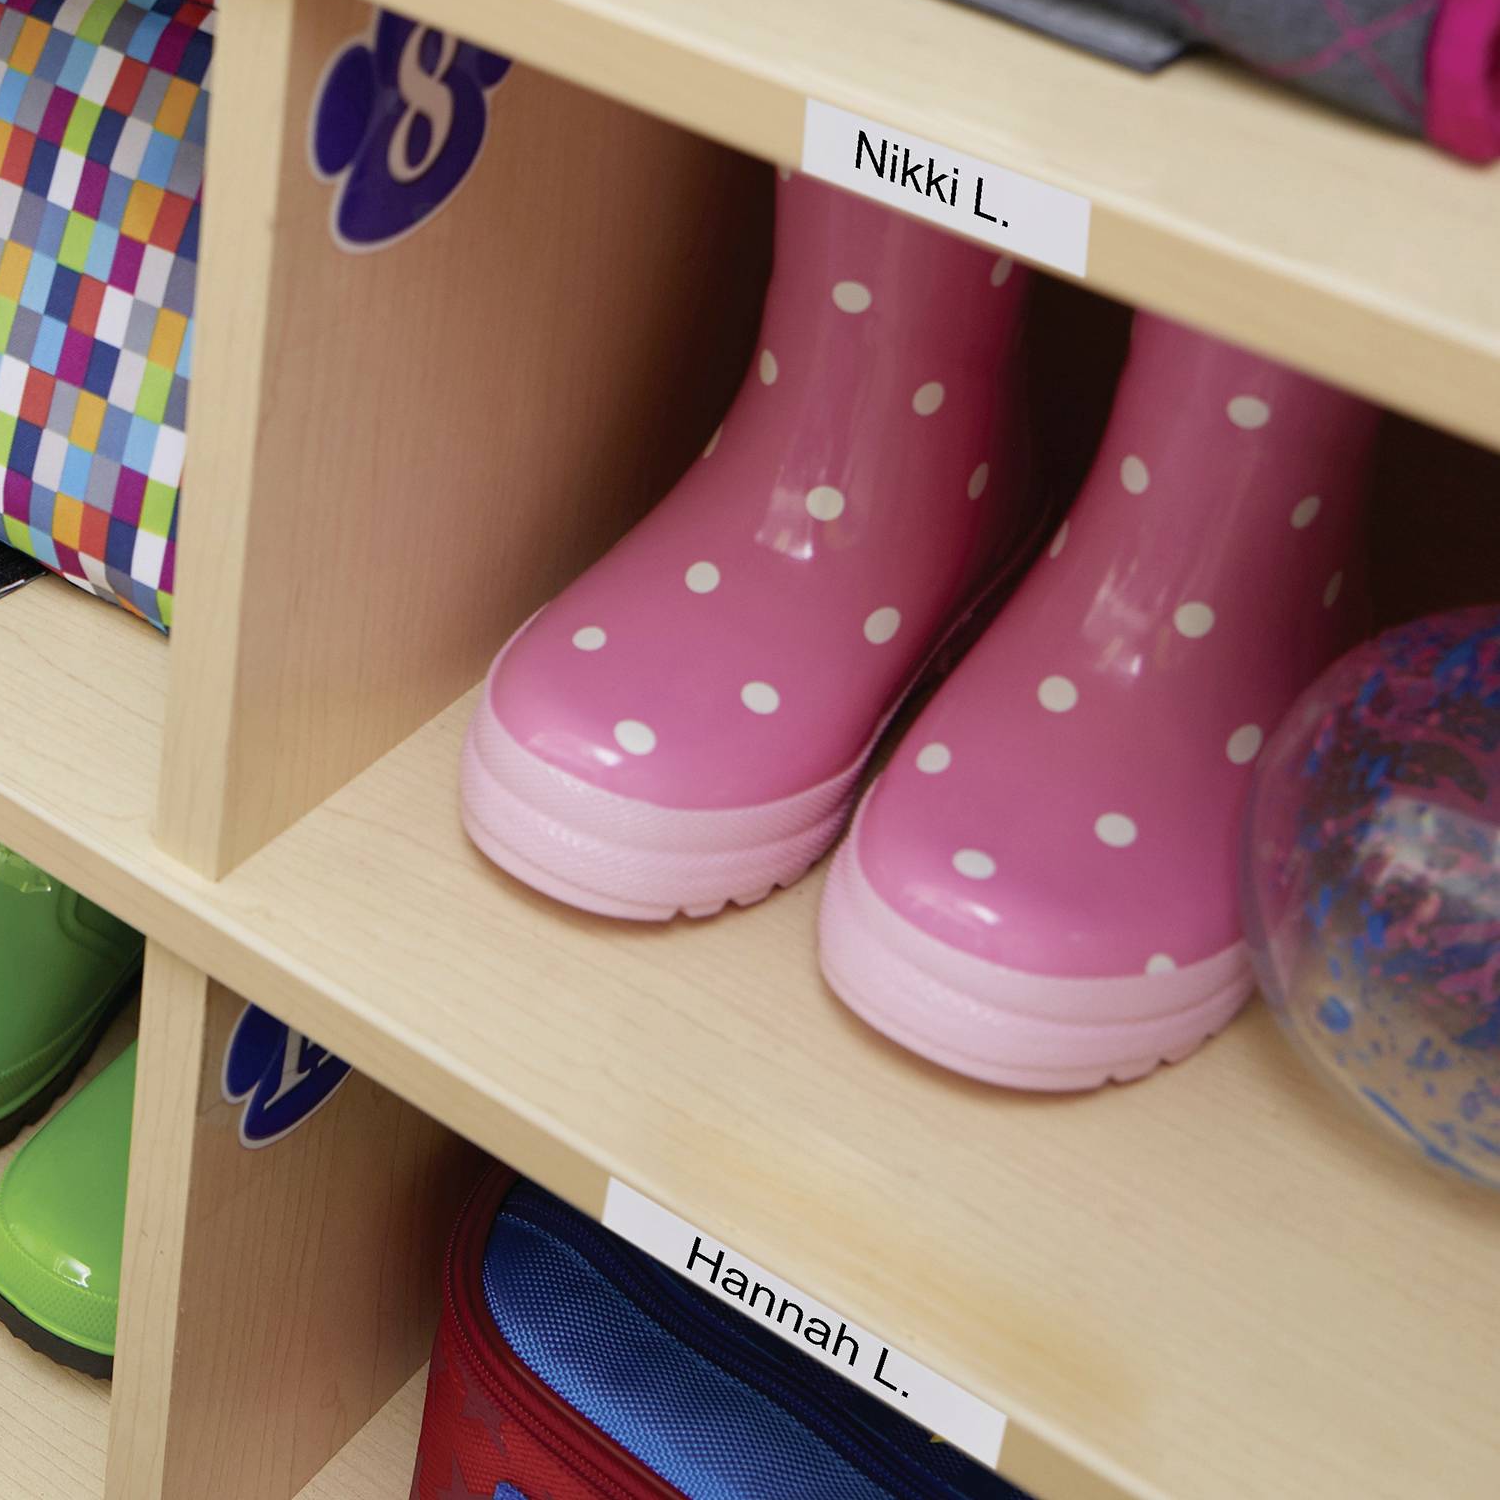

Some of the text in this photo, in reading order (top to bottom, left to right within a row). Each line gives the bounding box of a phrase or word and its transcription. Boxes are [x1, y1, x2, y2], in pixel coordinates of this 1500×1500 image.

[387, 22, 458, 185] 8
[855, 129, 1009, 228] Nikki L.
[686, 1236, 909, 1398] Hannah L.
